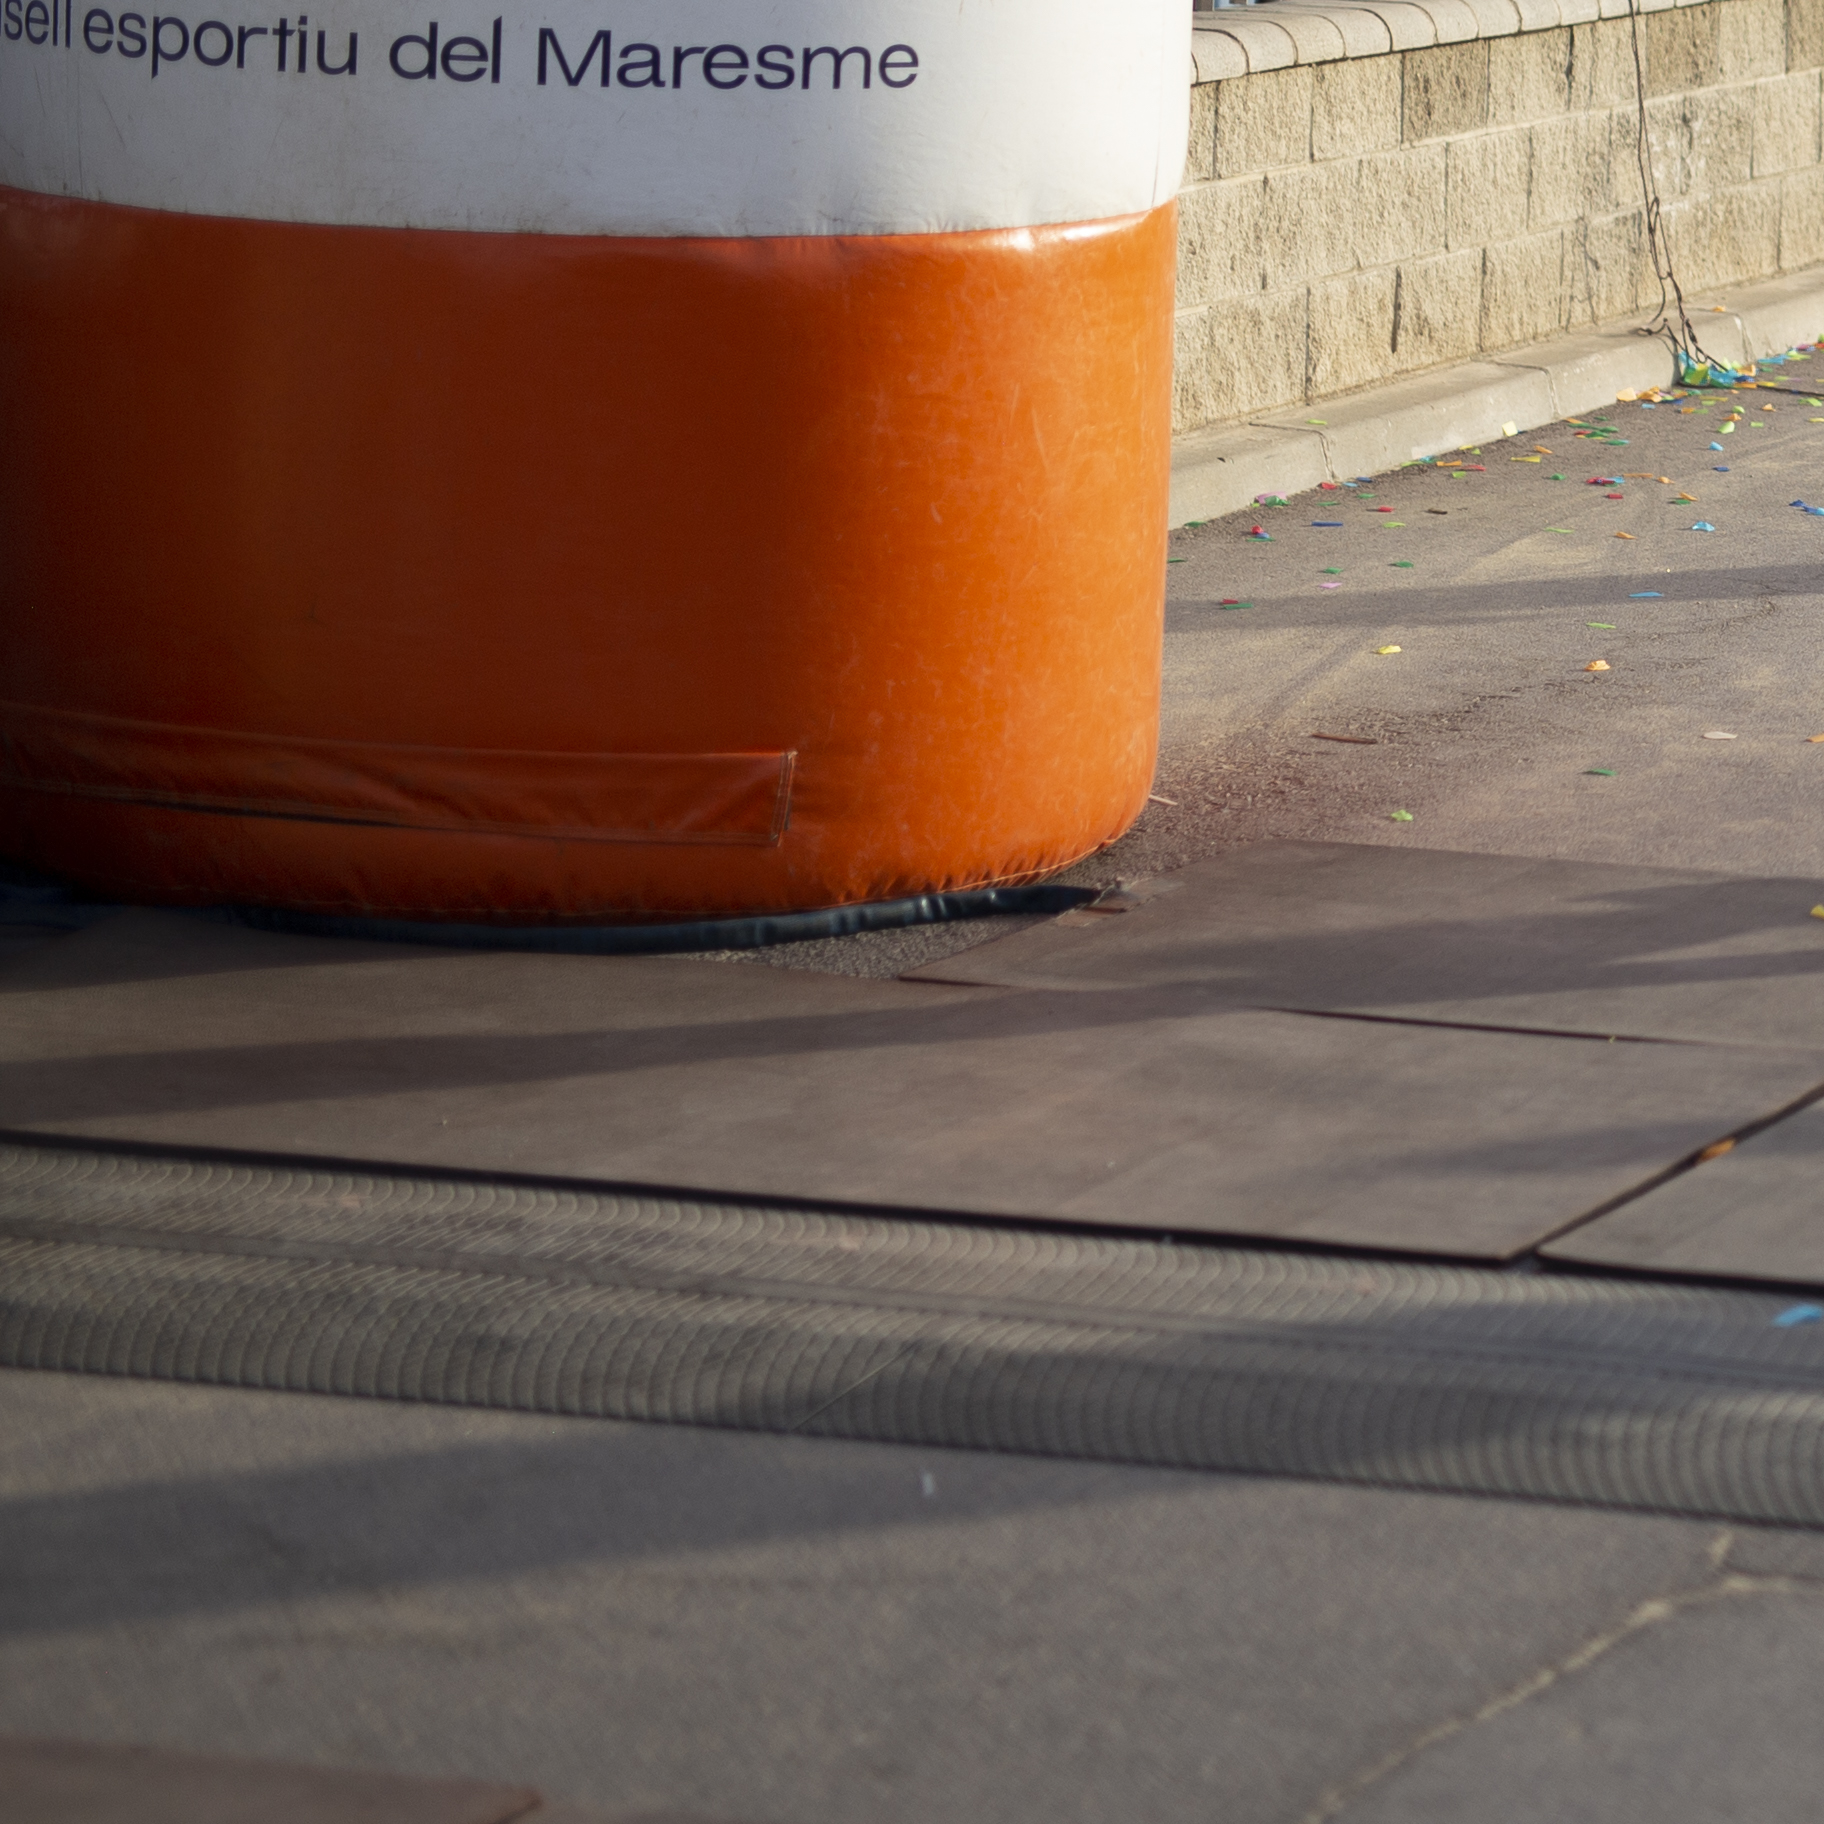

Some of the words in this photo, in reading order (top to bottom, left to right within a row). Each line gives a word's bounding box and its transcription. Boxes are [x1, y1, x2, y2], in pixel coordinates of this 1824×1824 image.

[83, 7, 358, 80] esportiu
[390, 16, 502, 84] del
[538, 26, 920, 90] Maresme
